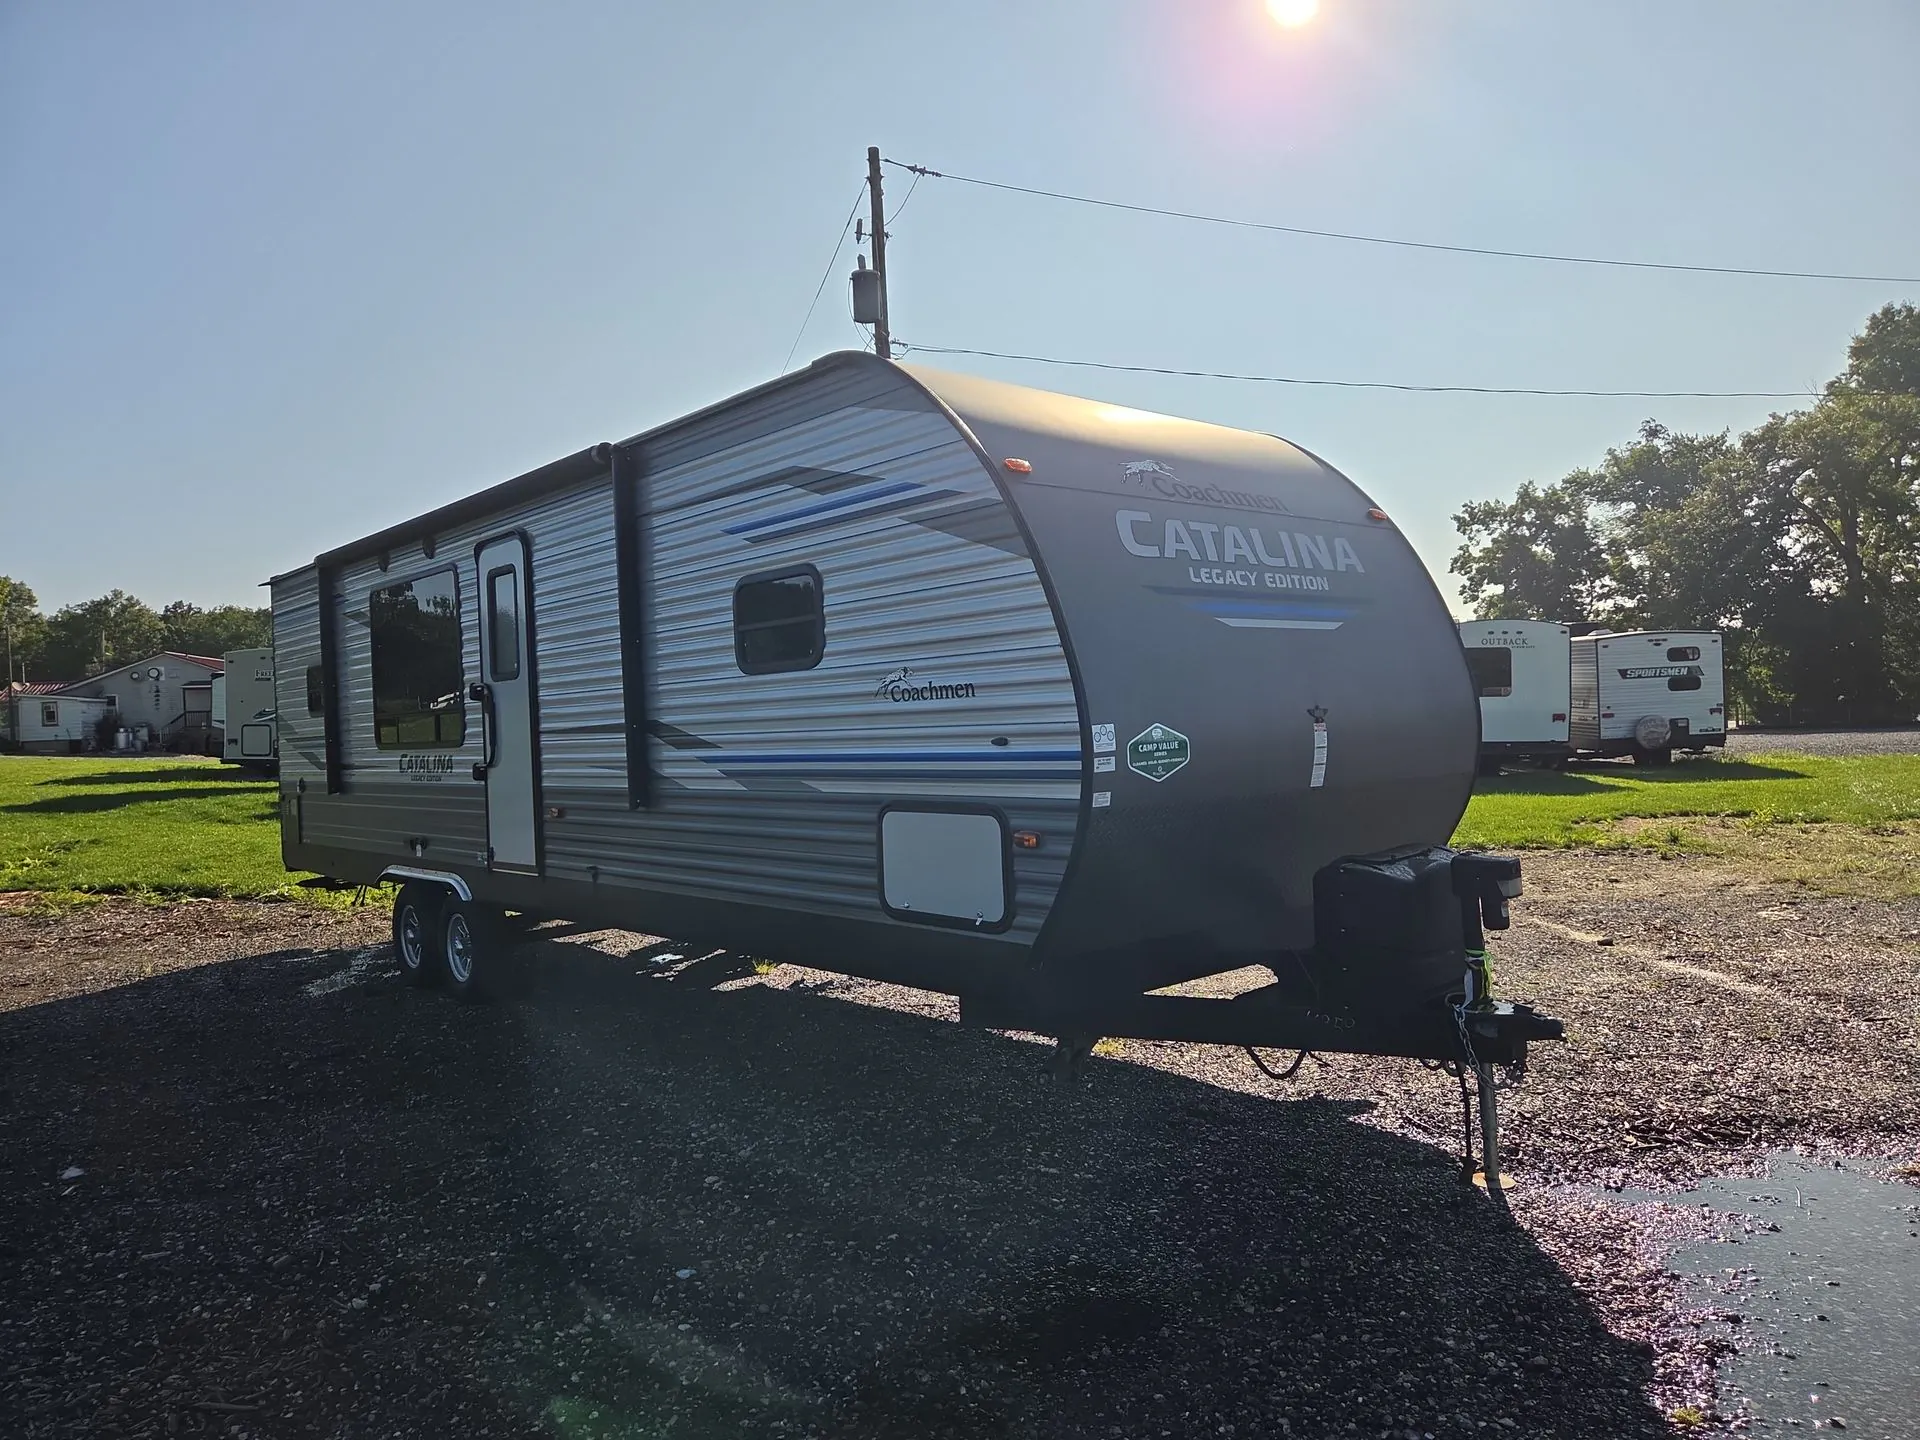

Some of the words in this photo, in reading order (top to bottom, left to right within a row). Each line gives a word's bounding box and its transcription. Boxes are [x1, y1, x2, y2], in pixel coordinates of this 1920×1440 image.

[1152, 476, 1290, 513] Coachmen
[1115, 509, 1366, 574] CATALINA
[1188, 566, 1257, 586] LEGACY
[1264, 572, 1330, 591] EDITION
[1481, 637, 1528, 646] OUTBACK
[1626, 667, 1688, 678] SPORTSMEN
[890, 681, 976, 703] Coachmen
[1138, 743, 1157, 753] CAMP
[1158, 741, 1179, 751] VALUE
[399, 753, 453, 774] CATALINA
